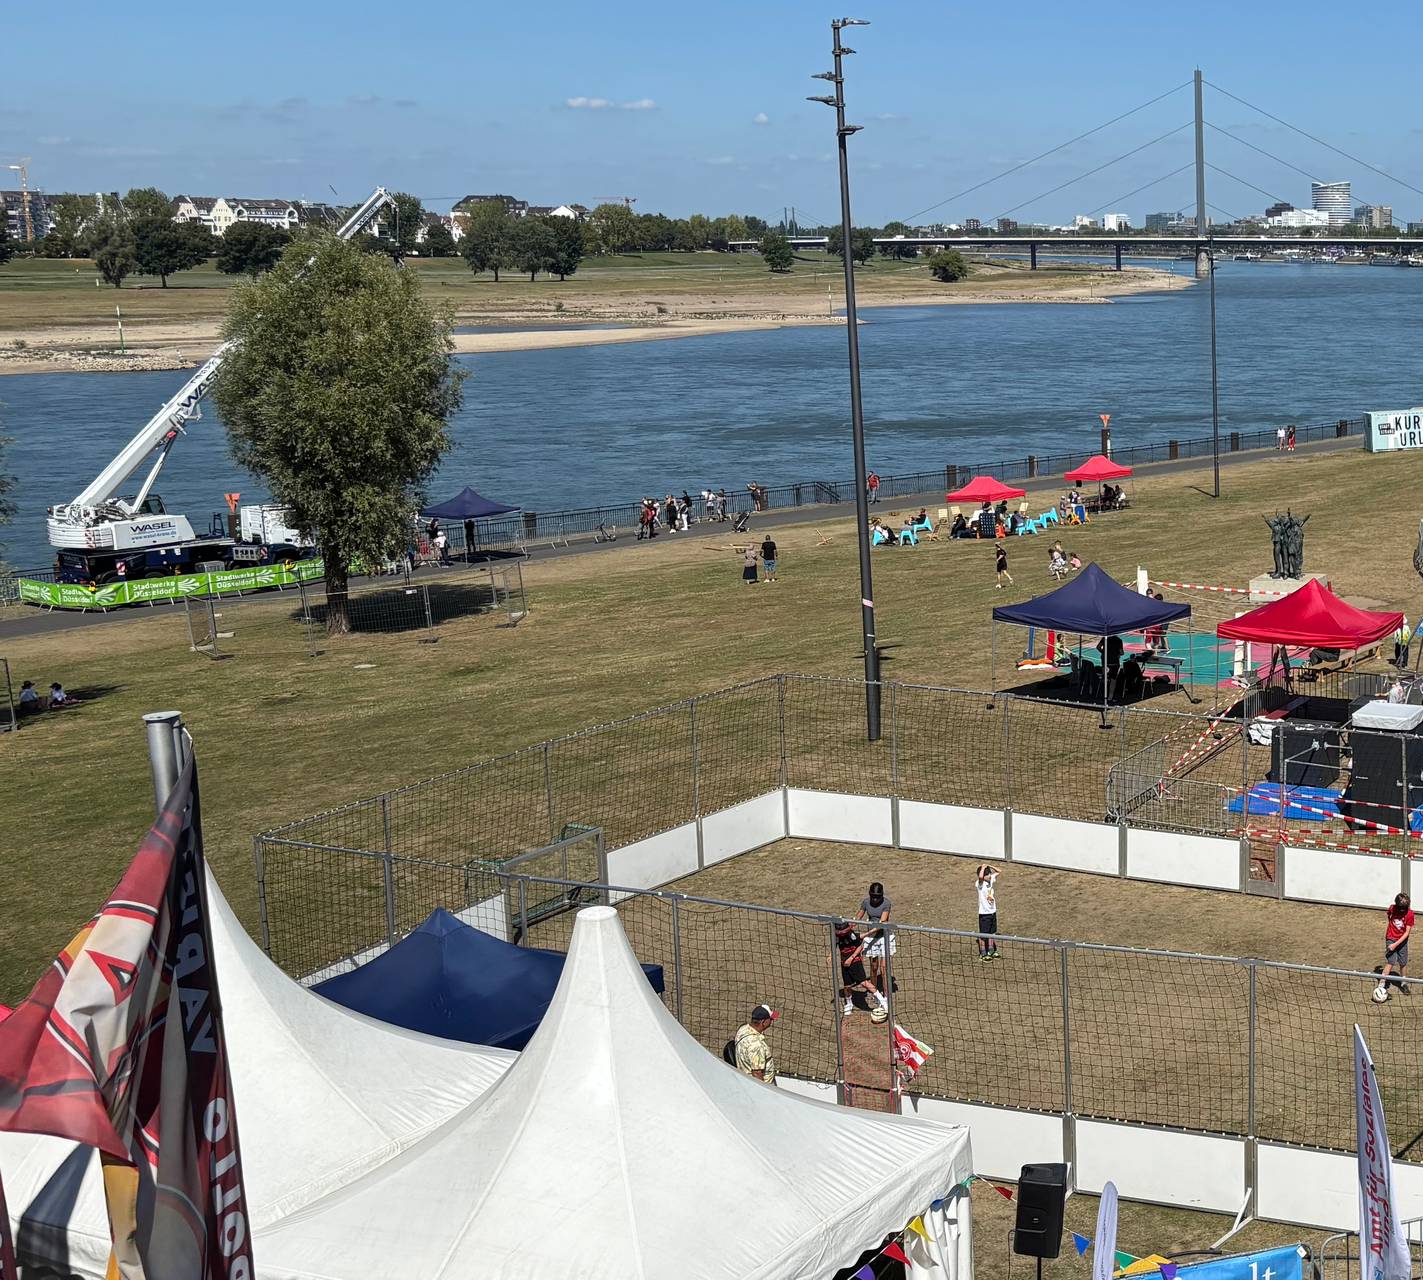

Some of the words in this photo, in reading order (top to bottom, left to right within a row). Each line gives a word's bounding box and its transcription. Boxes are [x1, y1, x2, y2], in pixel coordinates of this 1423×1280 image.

[181, 362, 225, 408] WASE
[130, 521, 176, 533] WASEL
[216, 572, 255, 581] Stadtwerke
[133, 582, 176, 590] Stadtwerke
[217, 579, 255, 589] Düsseldorf
[134, 587, 176, 598] Düsseldorf
[1361, 1058, 1376, 1162] Soziales
[1366, 1163, 1385, 1204] für
[1369, 1207, 1384, 1261] Amt
